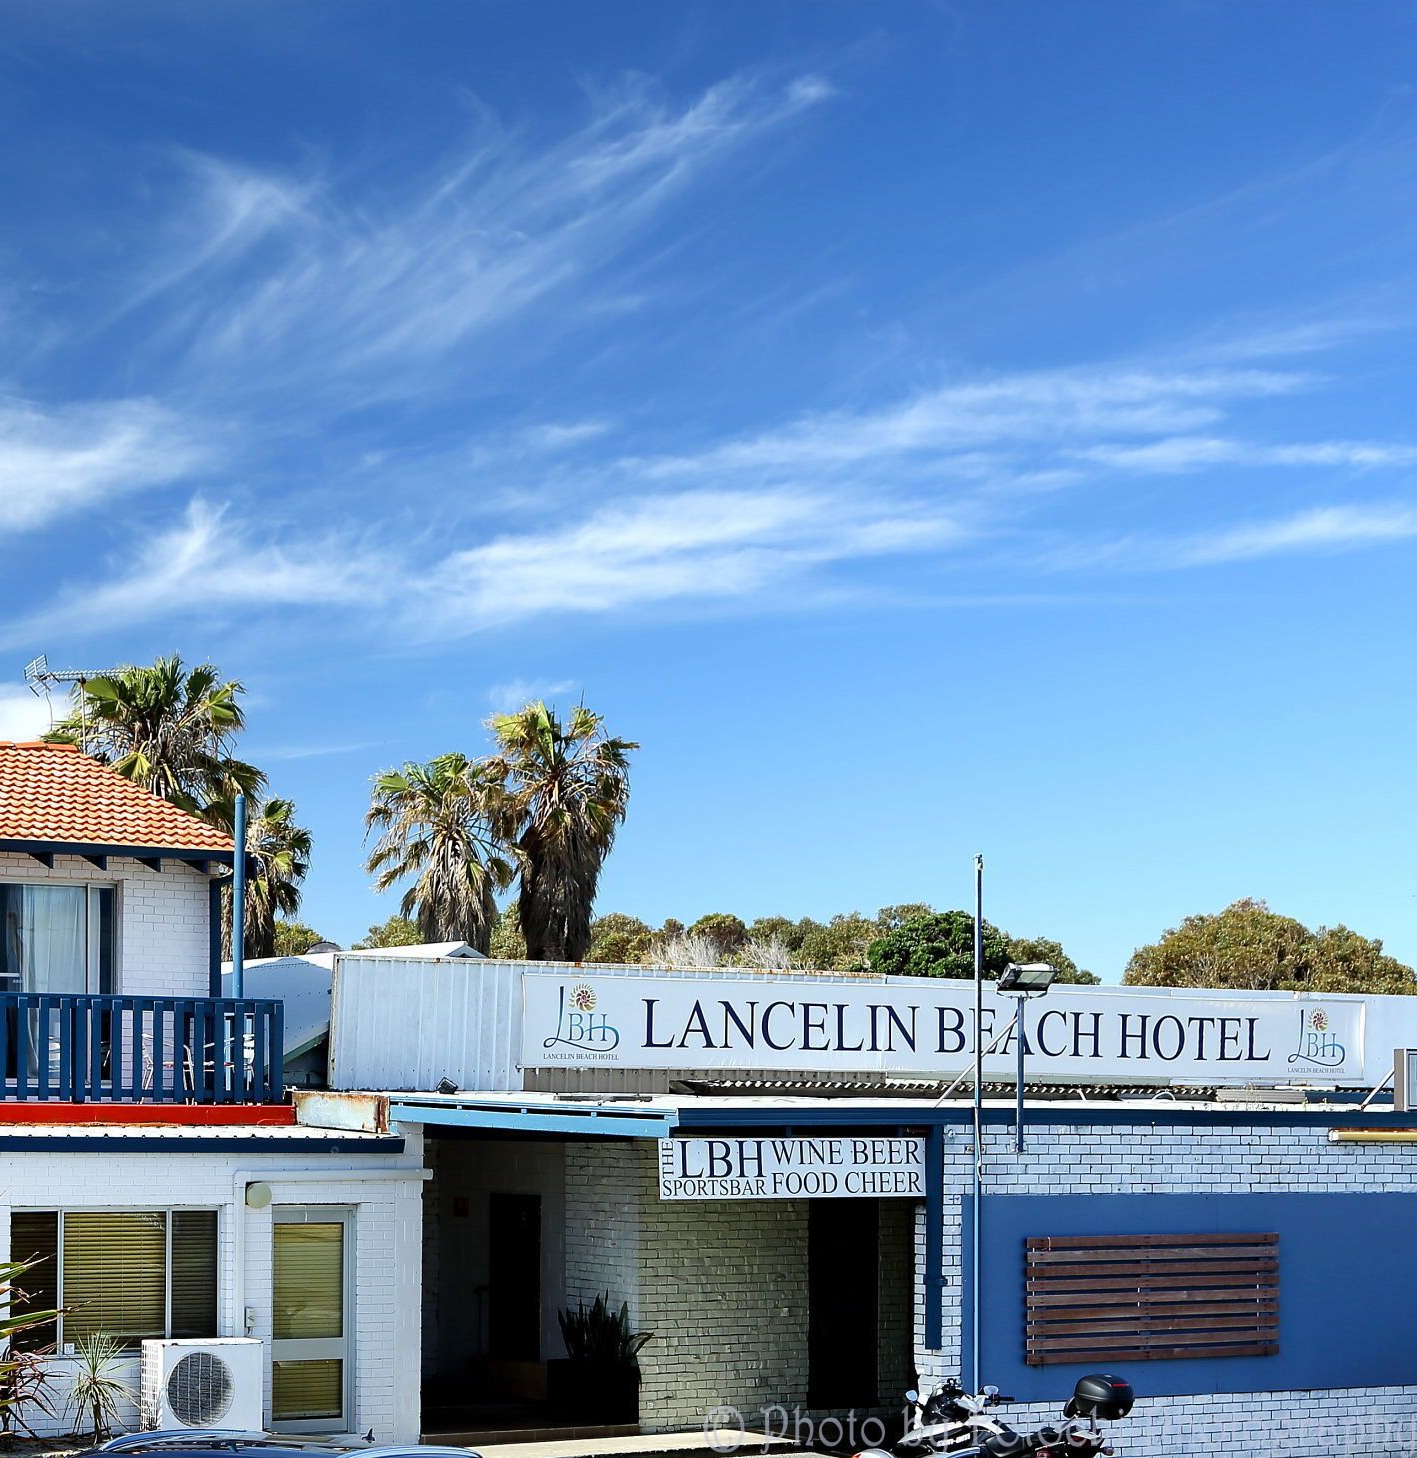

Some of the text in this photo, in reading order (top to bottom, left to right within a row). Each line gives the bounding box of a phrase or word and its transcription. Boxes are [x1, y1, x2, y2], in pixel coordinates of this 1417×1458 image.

[543, 986, 620, 1052] LBH
[640, 998, 1272, 1062] LANCELIN BEACH HOTEL
[1287, 1009, 1346, 1067] LBH
[662, 1140, 674, 1178] THE
[677, 1140, 767, 1178] LBH
[771, 1140, 922, 1165] WINE BEER
[663, 1179, 767, 1196] SPORTSBAR
[772, 1171, 923, 1194] FOOD CHEER
